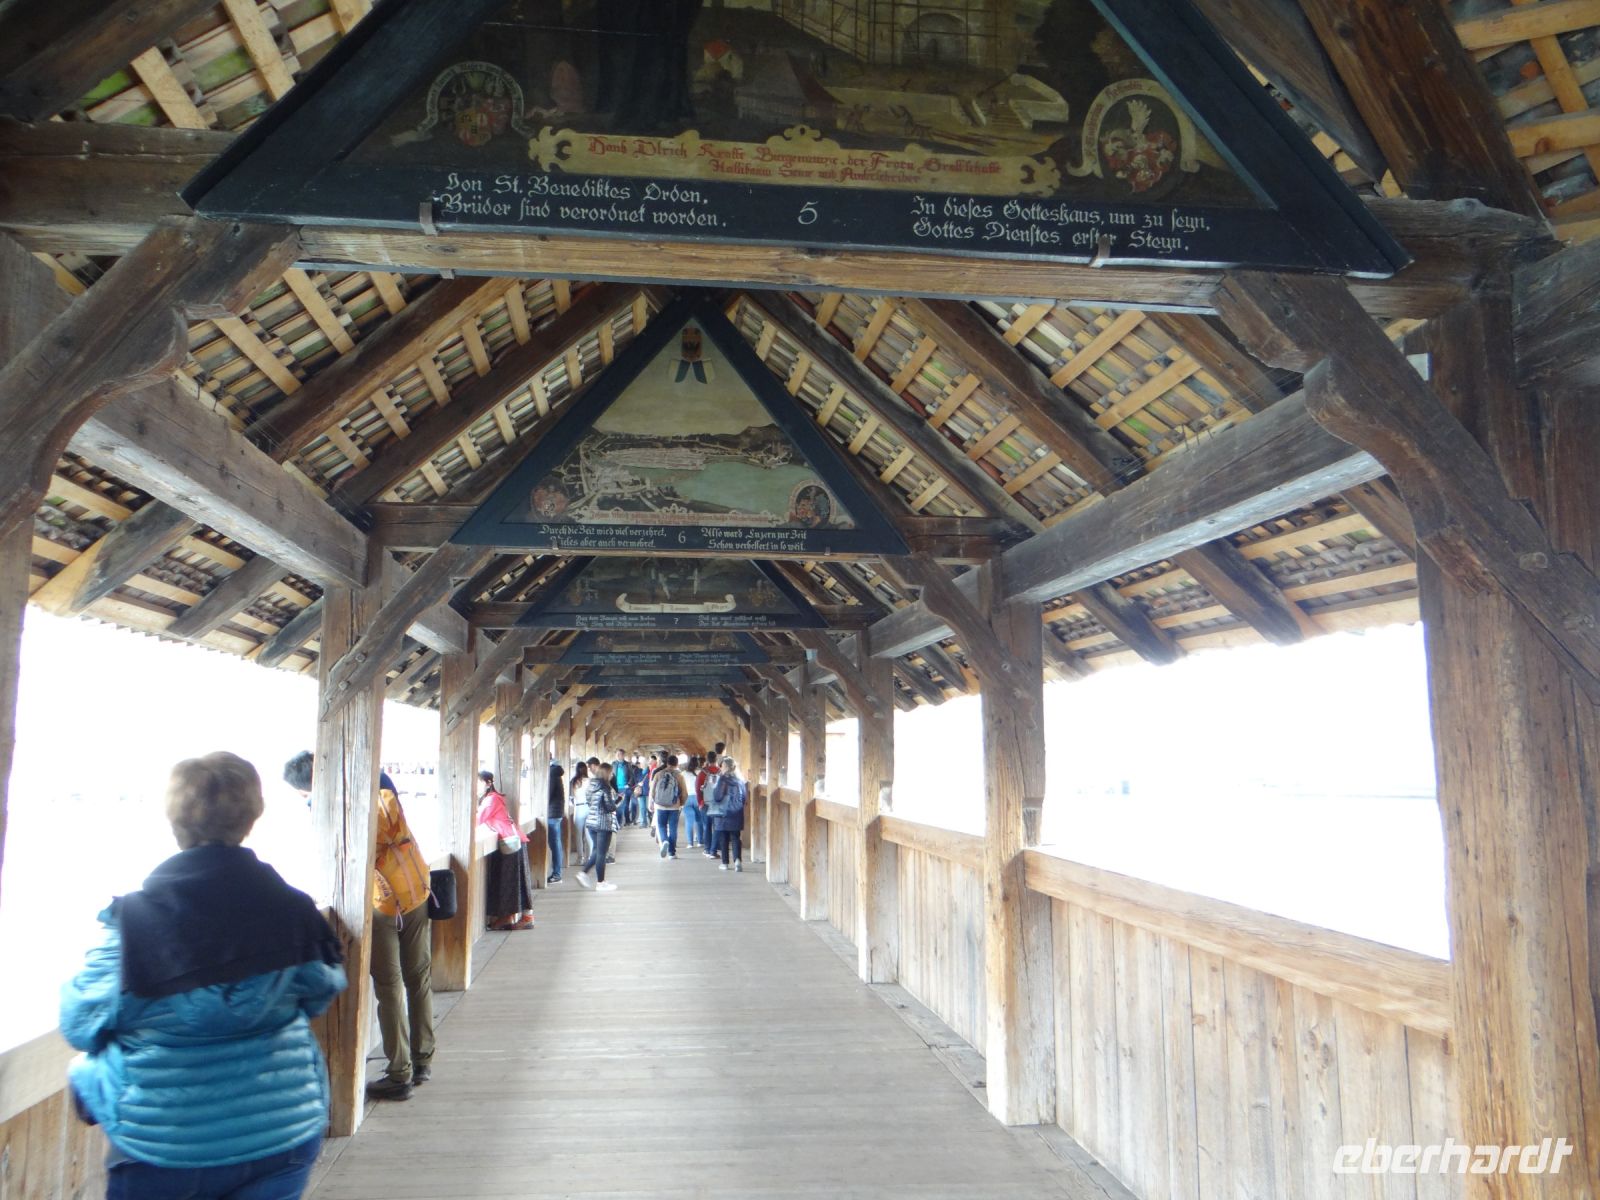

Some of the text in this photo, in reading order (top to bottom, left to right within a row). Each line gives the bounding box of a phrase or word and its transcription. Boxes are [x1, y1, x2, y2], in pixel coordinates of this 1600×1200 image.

[446, 172, 482, 192] Von
[494, 175, 524, 194] St.
[528, 175, 631, 200] Benediktes
[440, 192, 511, 216] Brüder
[560, 203, 646, 223] verordnet
[652, 208, 727, 228] worden.
[797, 200, 819, 225] 5
[910, 195, 935, 215] In
[943, 196, 993, 221] dieses
[1110, 211, 1135, 225] um
[1142, 213, 1164, 229] zu
[913, 216, 975, 239] Gottes
[568, 524, 578, 535] die
[597, 526, 614, 536] wird
[678, 530, 686, 544] 6
[580, 537, 597, 547] aber
[598, 537, 616, 548] auch
